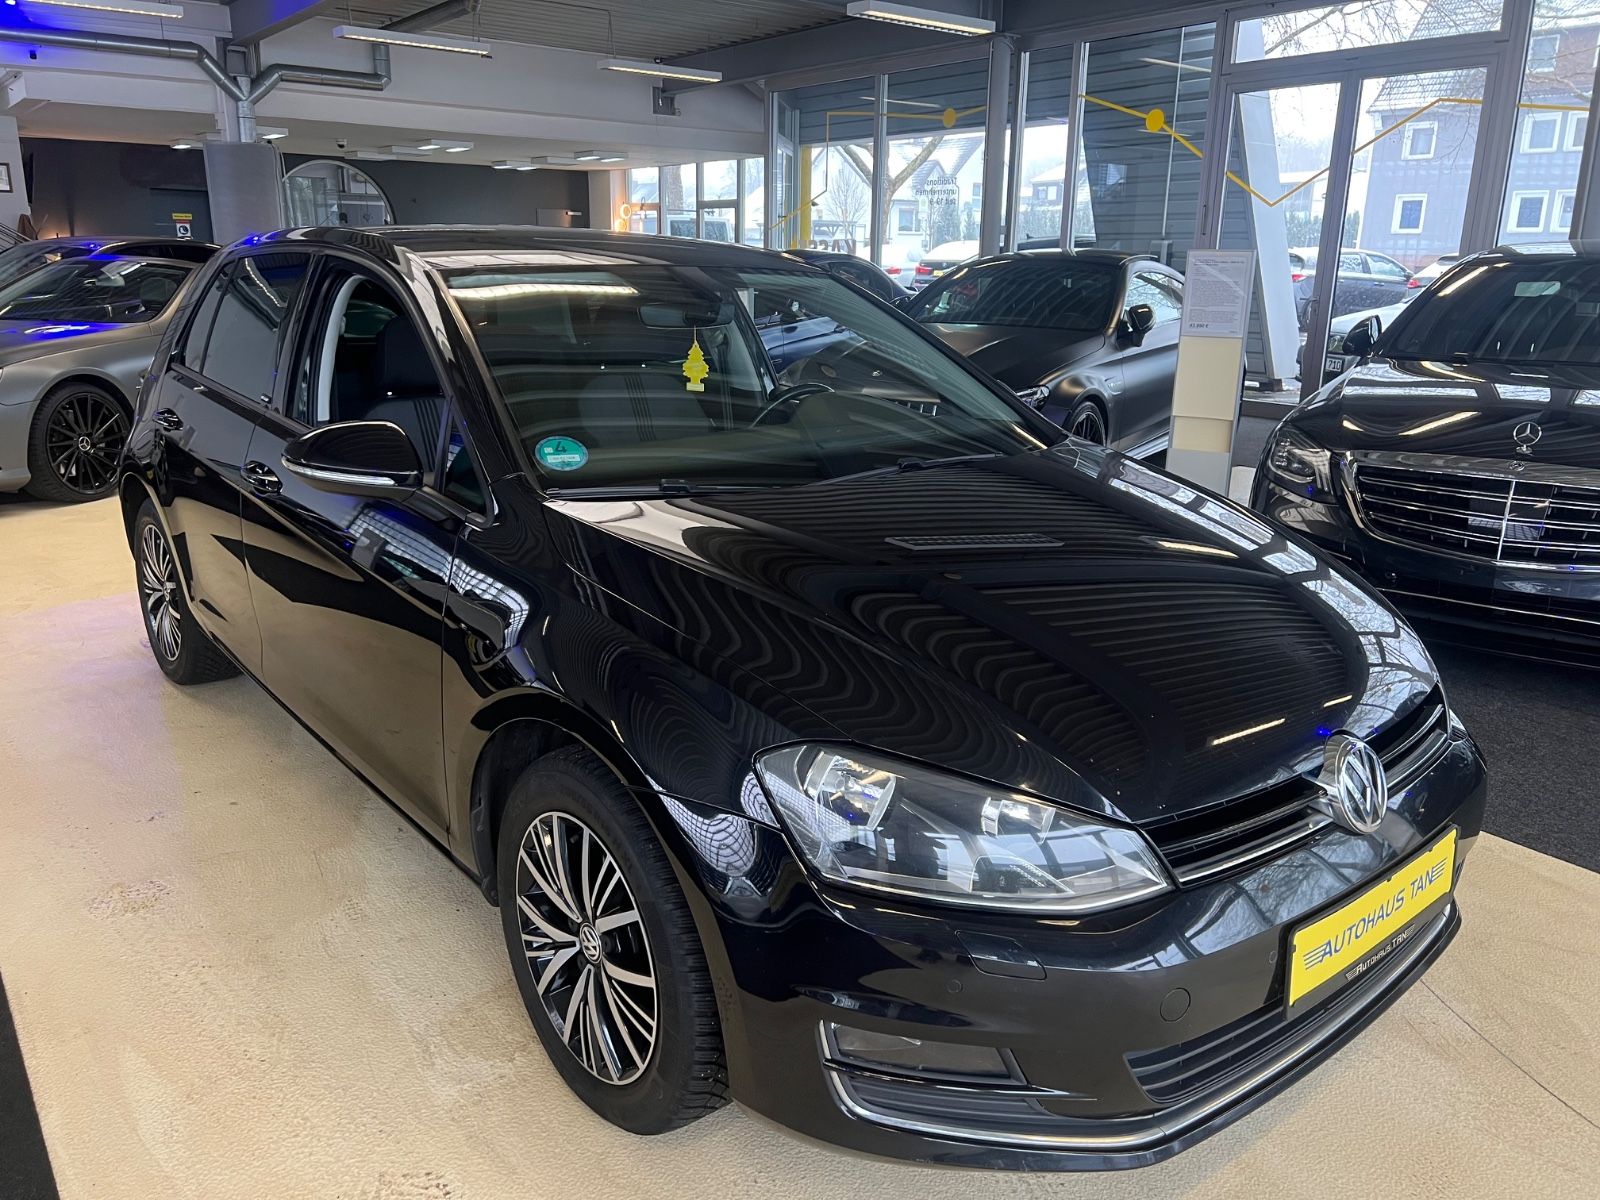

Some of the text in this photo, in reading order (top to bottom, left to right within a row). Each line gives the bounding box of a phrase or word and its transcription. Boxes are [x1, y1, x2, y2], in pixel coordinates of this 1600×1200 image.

[555, 441, 567, 453] 4
[1319, 865, 1438, 963] AUTOHAUS TAN
